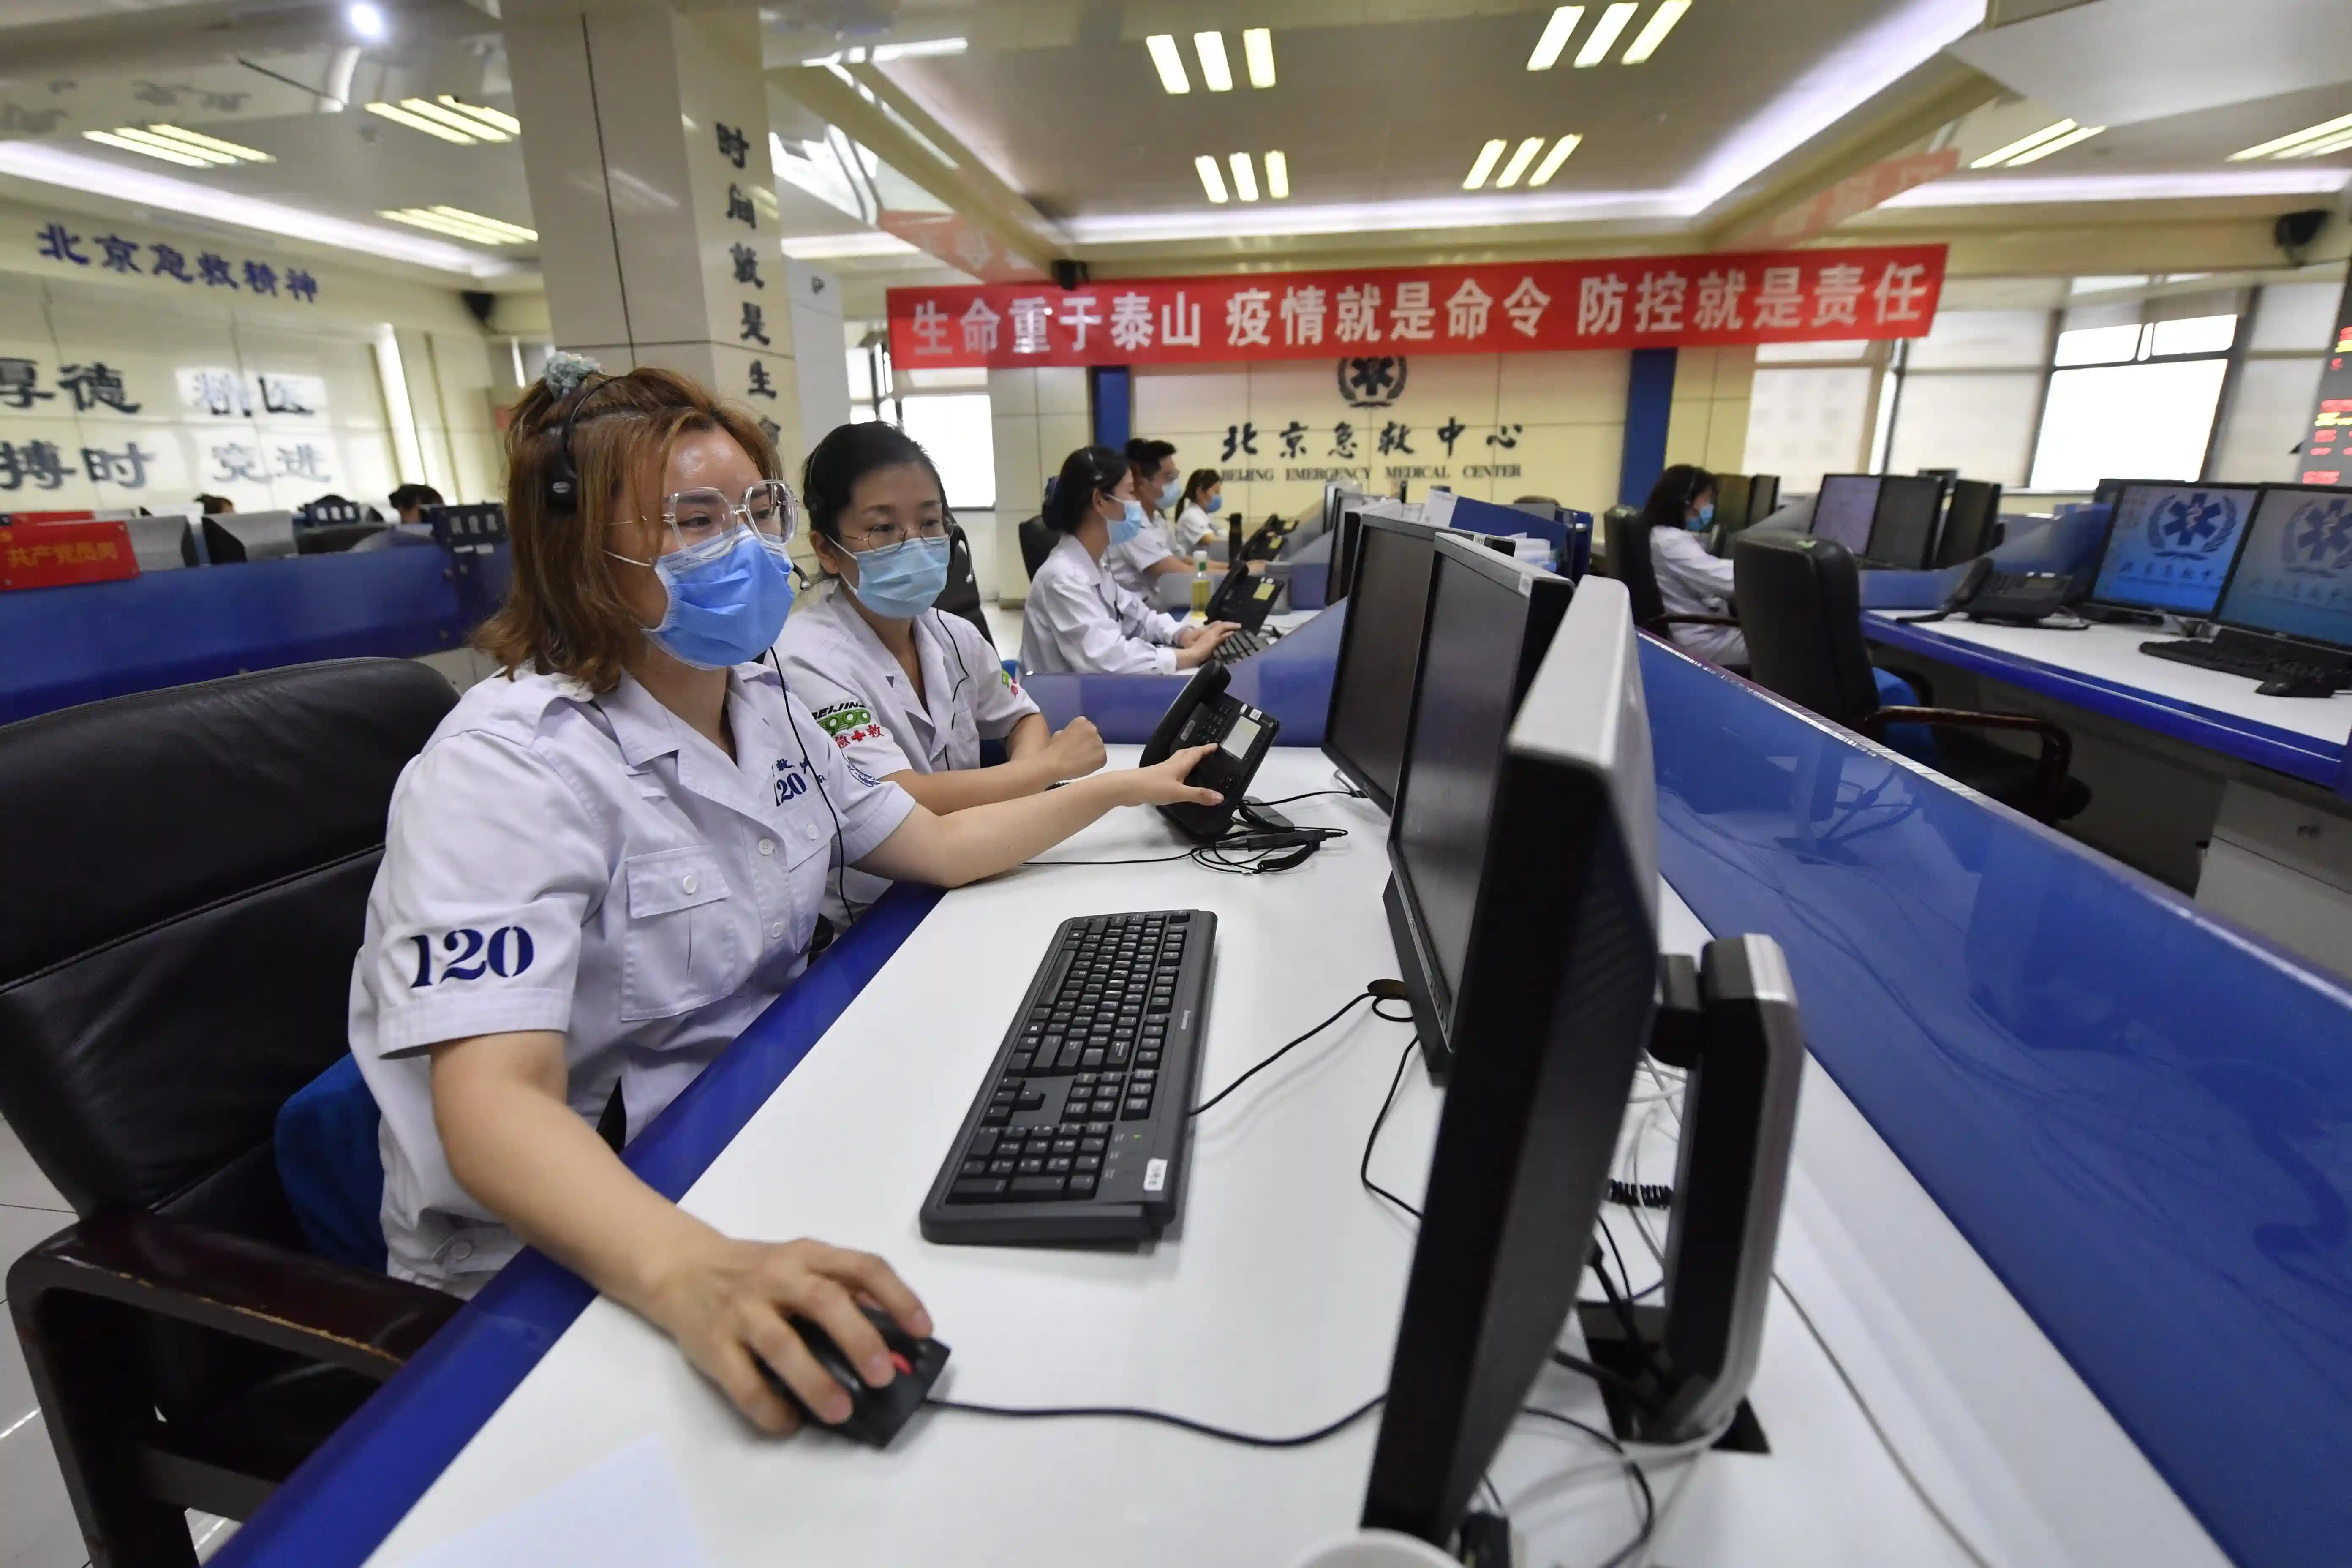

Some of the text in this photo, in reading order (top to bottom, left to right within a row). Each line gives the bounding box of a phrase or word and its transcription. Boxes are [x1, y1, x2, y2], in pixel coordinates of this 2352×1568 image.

[36, 223, 318, 304] 北京急救精神
[912, 261, 1928, 355] 生命重于泰山 疫情就是命令 防控就是责任
[1221, 416, 1522, 462] 北京急救中心
[1285, 466, 1370, 481] EMERGENCY
[1385, 465, 1451, 479] MEDICAL
[1462, 464, 1522, 478] CENTER
[408, 926, 534, 988] 120
